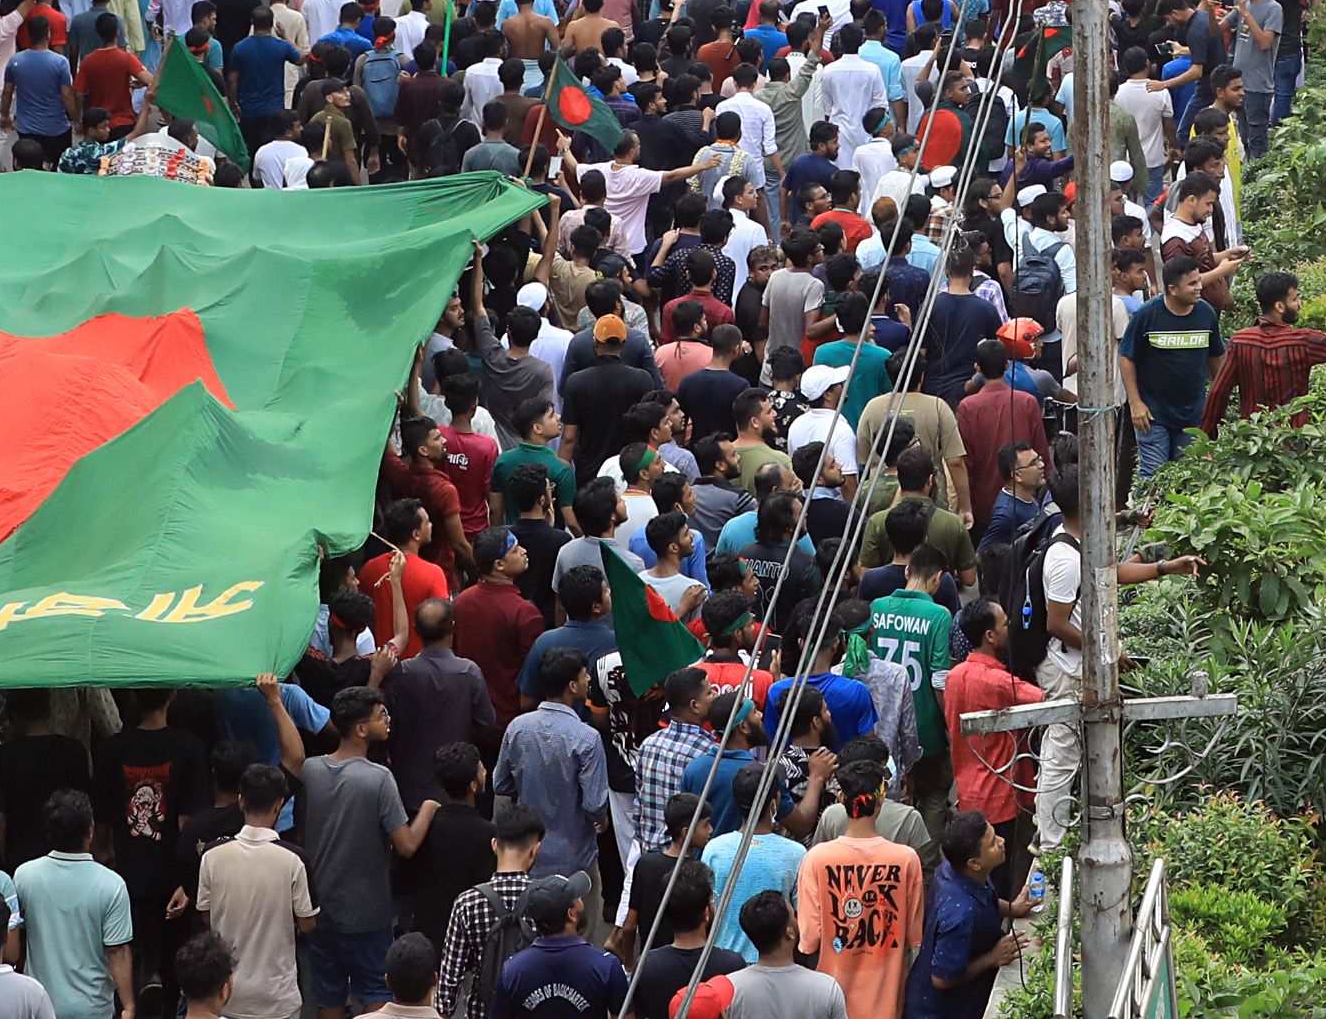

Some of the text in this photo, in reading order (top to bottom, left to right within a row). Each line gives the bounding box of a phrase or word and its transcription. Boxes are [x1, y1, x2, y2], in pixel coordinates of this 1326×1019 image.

[873, 612, 931, 636] SAFOWAN
[877, 637, 923, 691] 75
[825, 864, 899, 889] NEVER
